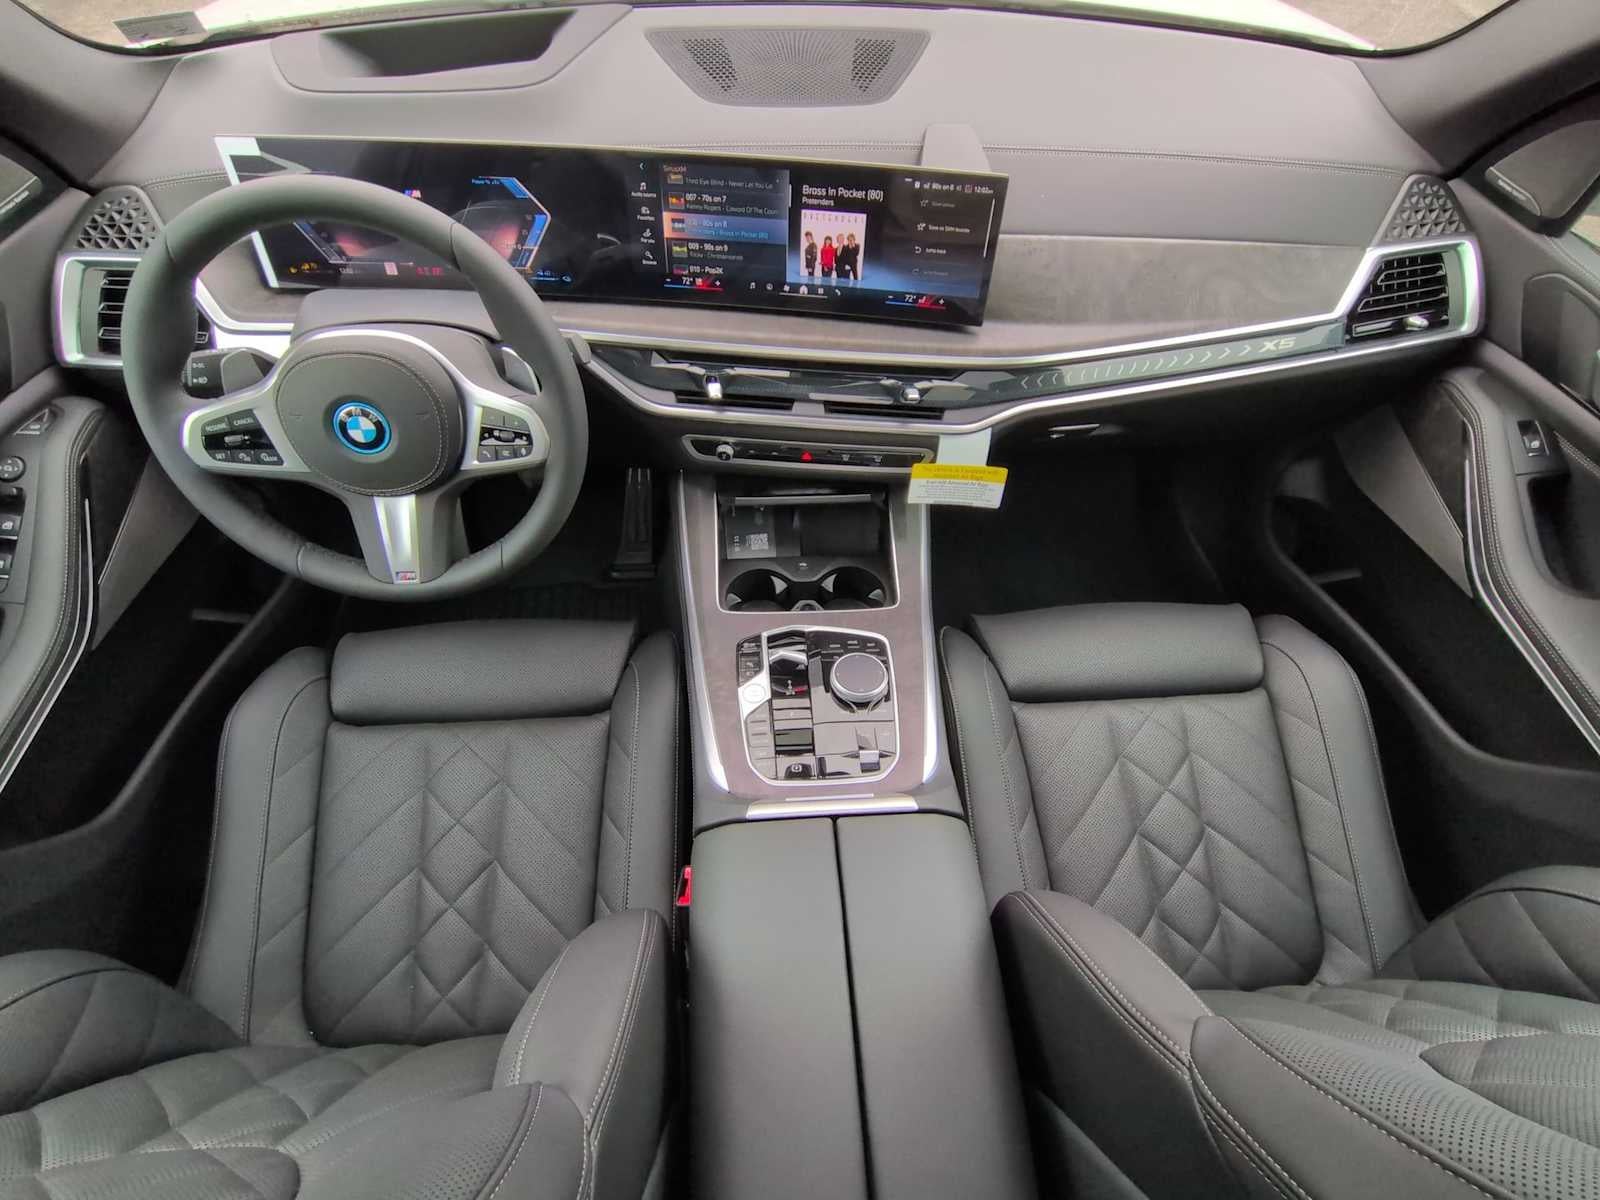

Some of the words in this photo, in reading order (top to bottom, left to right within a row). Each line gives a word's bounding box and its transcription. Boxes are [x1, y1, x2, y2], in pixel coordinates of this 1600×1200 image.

[702, 194, 712, 202] 70s
[802, 185, 826, 196] Brass
[838, 188, 866, 199] Pocket
[868, 190, 884, 202] (80)
[1259, 337, 1296, 352] X5
[340, 408, 378, 422] BMW
